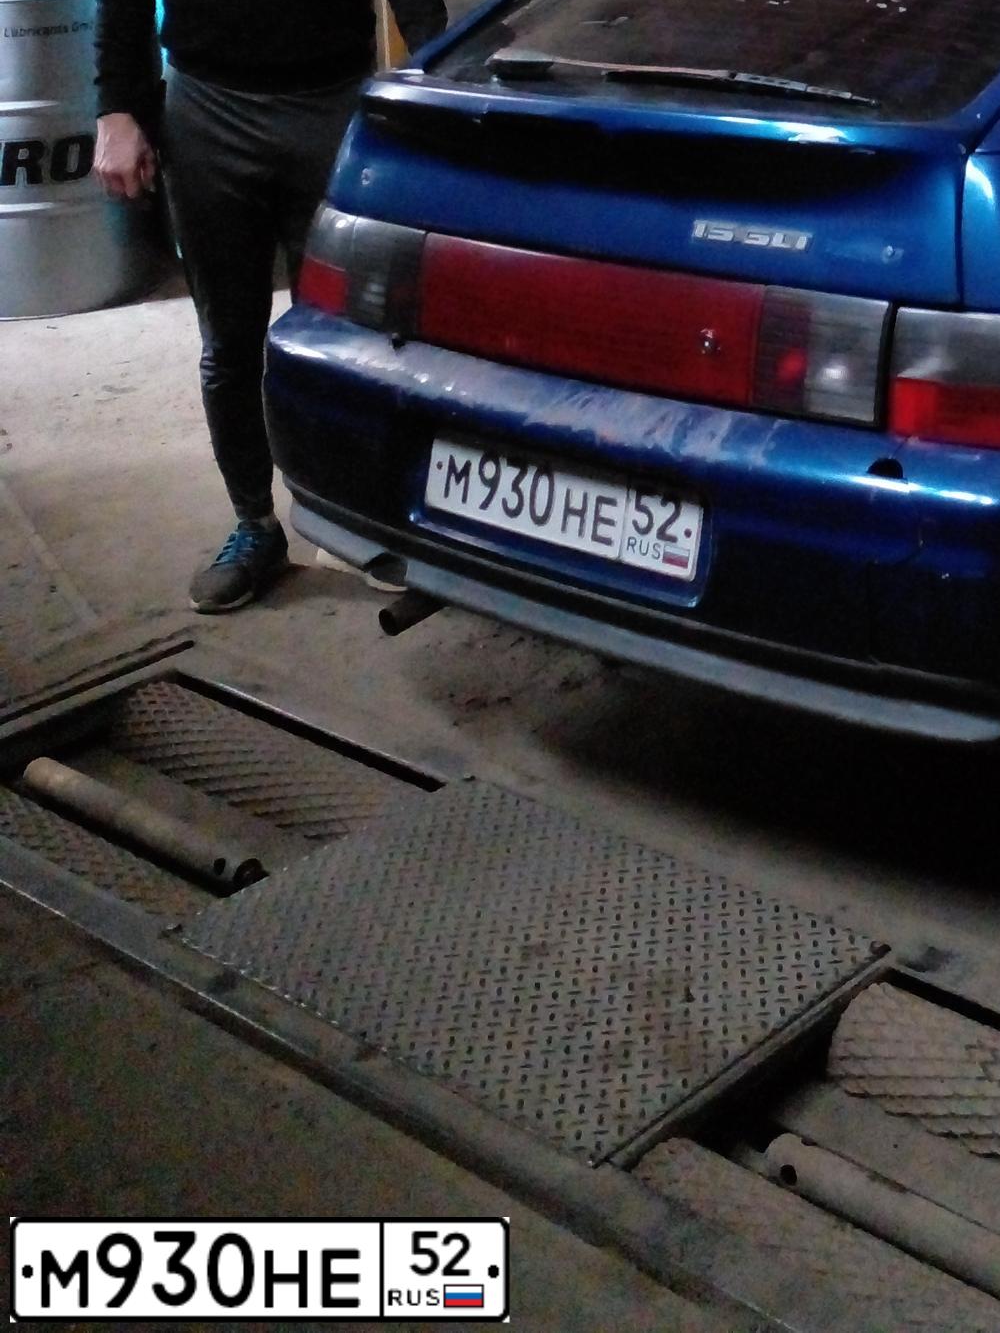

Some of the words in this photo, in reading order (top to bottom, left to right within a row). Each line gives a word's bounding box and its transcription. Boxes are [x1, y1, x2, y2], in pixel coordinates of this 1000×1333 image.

[0, 134, 95, 186] RO
[444, 452, 618, 546] М930НЕ
[631, 489, 682, 543] 52
[626, 536, 661, 560] RUS
